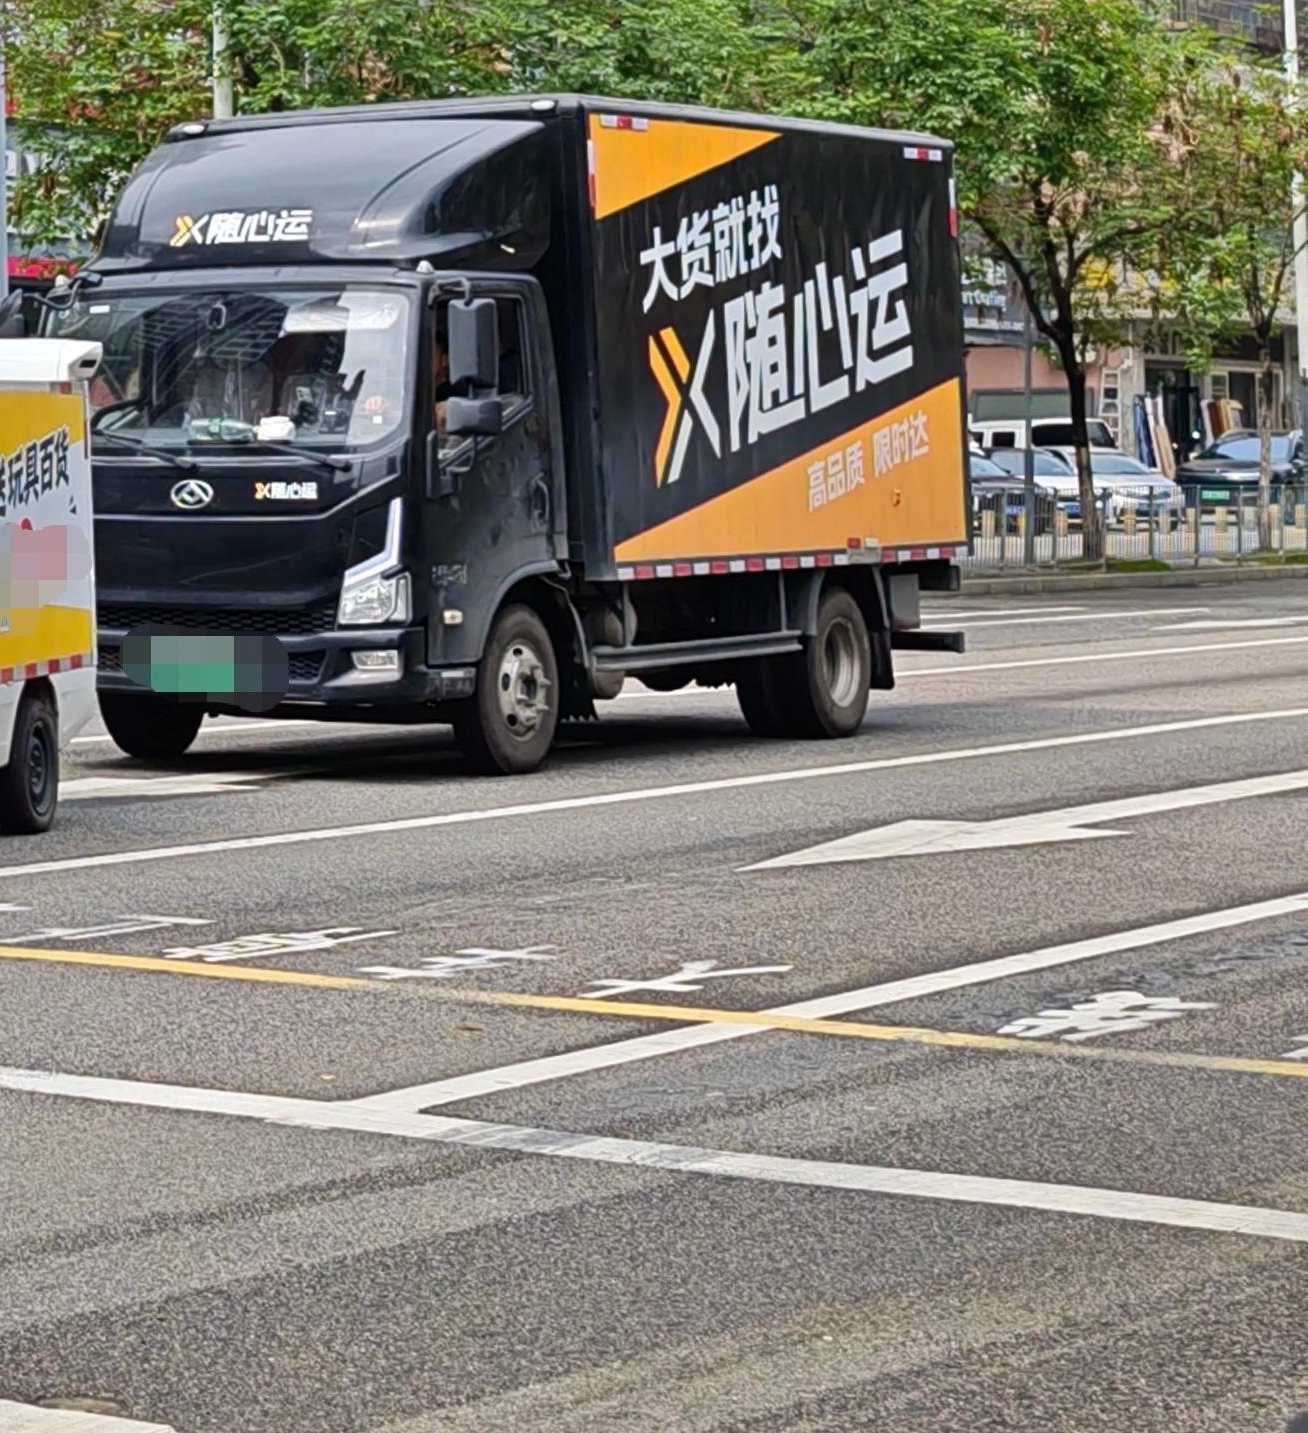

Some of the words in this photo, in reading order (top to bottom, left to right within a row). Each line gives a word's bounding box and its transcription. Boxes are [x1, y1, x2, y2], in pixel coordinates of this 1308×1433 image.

[640, 185, 782, 314] 大货就找
[807, 440, 867, 513] 高品质
[872, 410, 929, 477] 限时达
